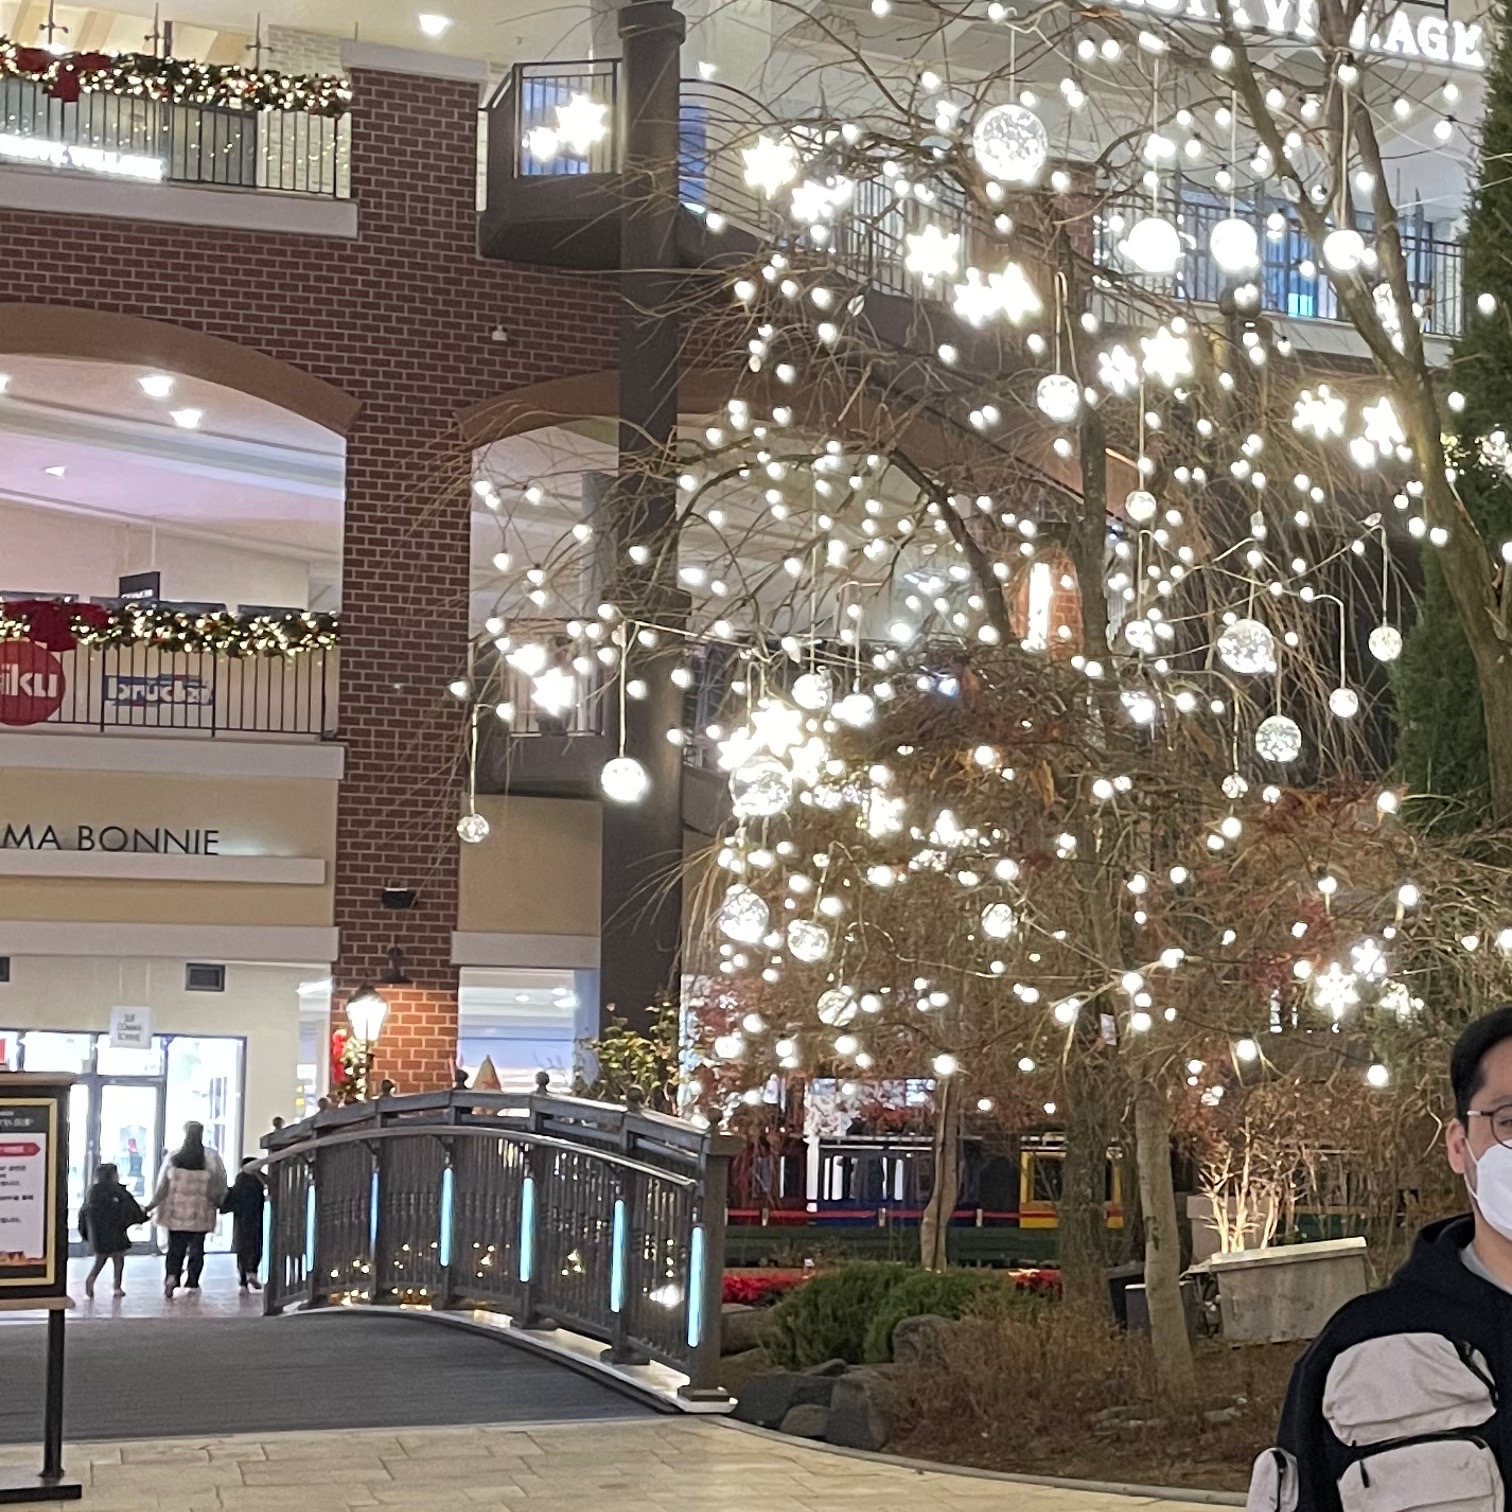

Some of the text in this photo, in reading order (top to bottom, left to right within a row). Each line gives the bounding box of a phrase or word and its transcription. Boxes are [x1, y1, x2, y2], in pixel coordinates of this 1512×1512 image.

[1262, 0, 1486, 67] VILAGE
[1, 823, 219, 856] MA BONNIE
